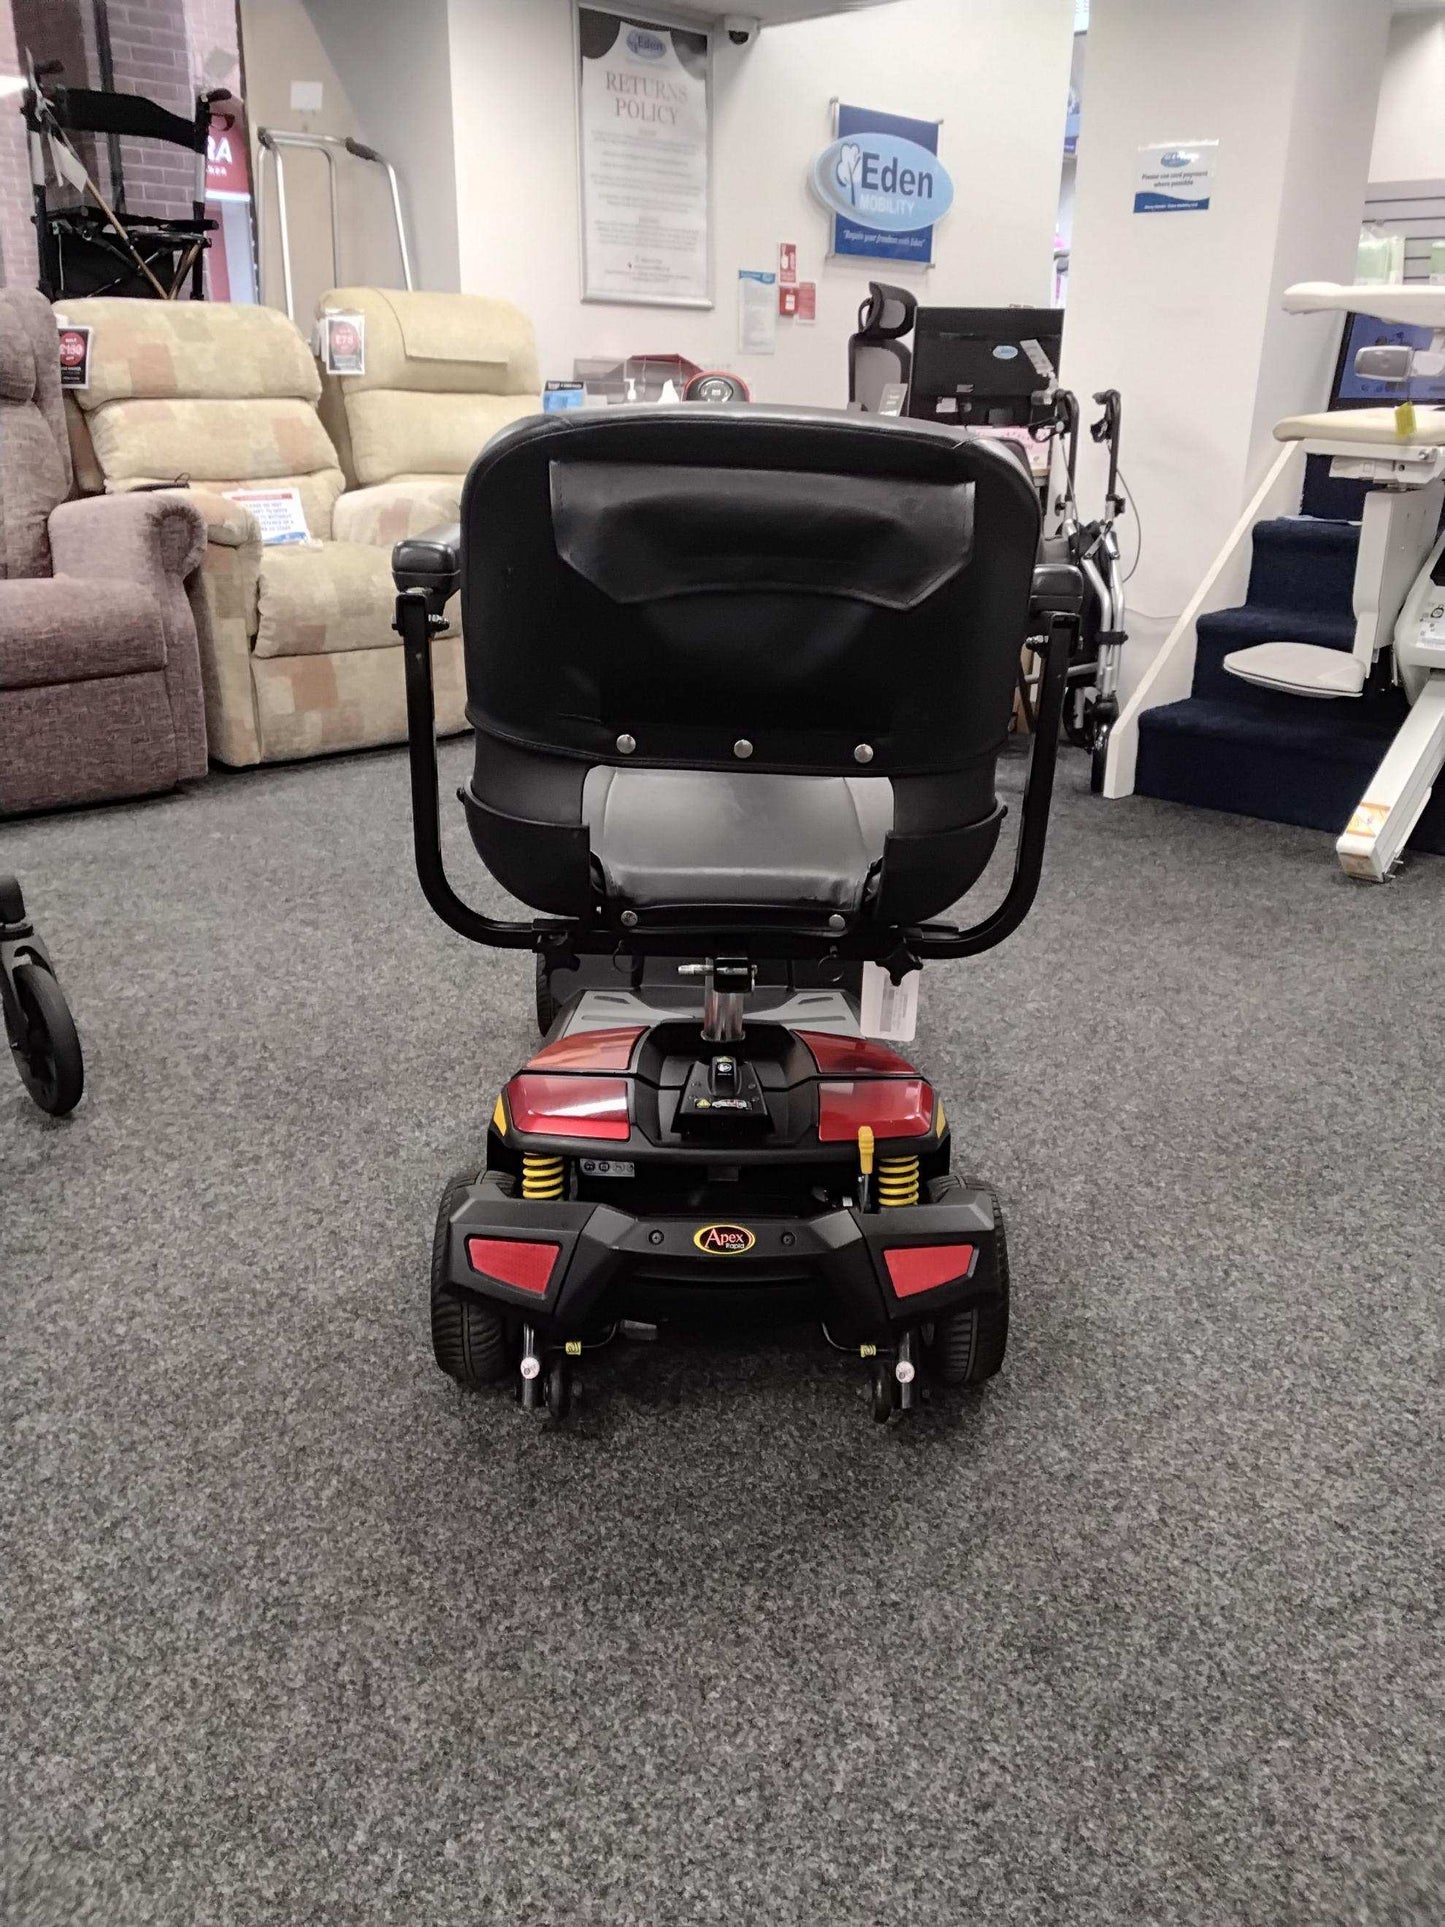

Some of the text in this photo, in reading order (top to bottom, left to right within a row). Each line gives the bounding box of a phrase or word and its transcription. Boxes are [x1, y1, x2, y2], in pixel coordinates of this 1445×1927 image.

[606, 70, 688, 104] RETURNS
[616, 97, 678, 125] POLICY
[861, 151, 933, 199] Eden
[860, 193, 915, 217] MOBILITY
[704, 1228, 744, 1248] Apex
